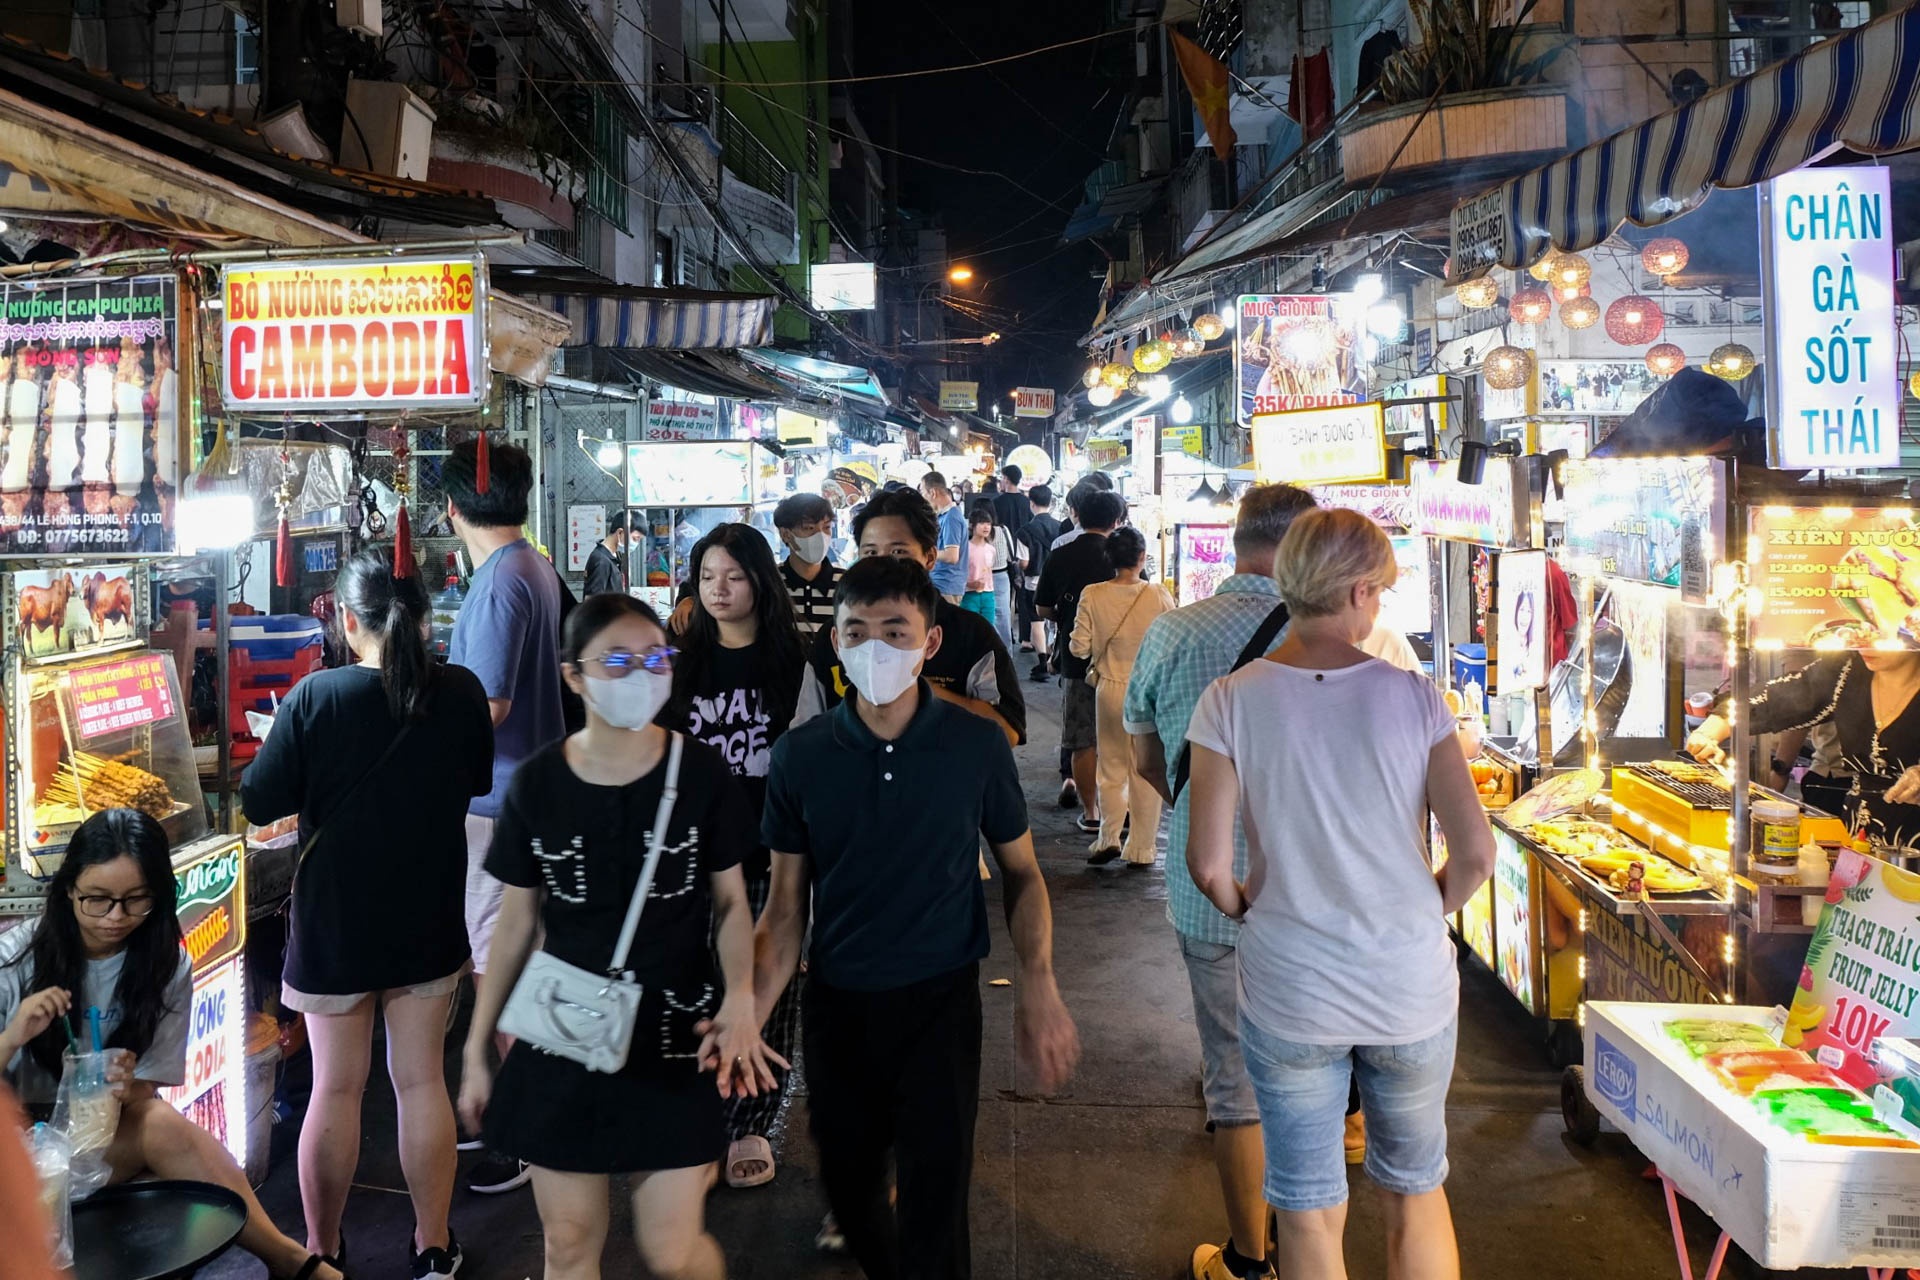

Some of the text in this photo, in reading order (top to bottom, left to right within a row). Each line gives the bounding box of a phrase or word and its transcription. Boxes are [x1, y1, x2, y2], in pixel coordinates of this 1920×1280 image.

[1785, 181, 1882, 242] CHÂN
[8, 292, 63, 318] NƯỚNG
[67, 296, 165, 316] CAMPUCHIA
[230, 271, 343, 319] BÒ NƯỚNG
[1812, 253, 1860, 312] GÀ
[1243, 302, 1275, 320] MỰC
[1279, 297, 1311, 317] GIÒN
[230, 320, 470, 400] CAMBODIA
[1805, 318, 1871, 384] SỐT
[1017, 389, 1053, 409] BÚN THÁI
[650, 429, 687, 440] 20K
[1800, 396, 1880, 455] THÁI
[45, 528, 129, 543] 0775673622
[83, 513, 122, 525] PHONG,
[141, 512, 162, 526] Q.10
[1768, 525, 1920, 547] XIÊN NƯỚ
[1769, 563, 1870, 575] 12.000 vnd
[1769, 586, 1869, 598] 15.000 vnd
[1830, 906, 1875, 951] THẠCH
[1878, 927, 1908, 968] TRÁI
[1829, 952, 1919, 1018] FRUIT JELLY
[1827, 996, 1891, 1062] 10K
[1597, 1052, 1632, 1096] LERØY
[1644, 1094, 1714, 1177] SALMON
